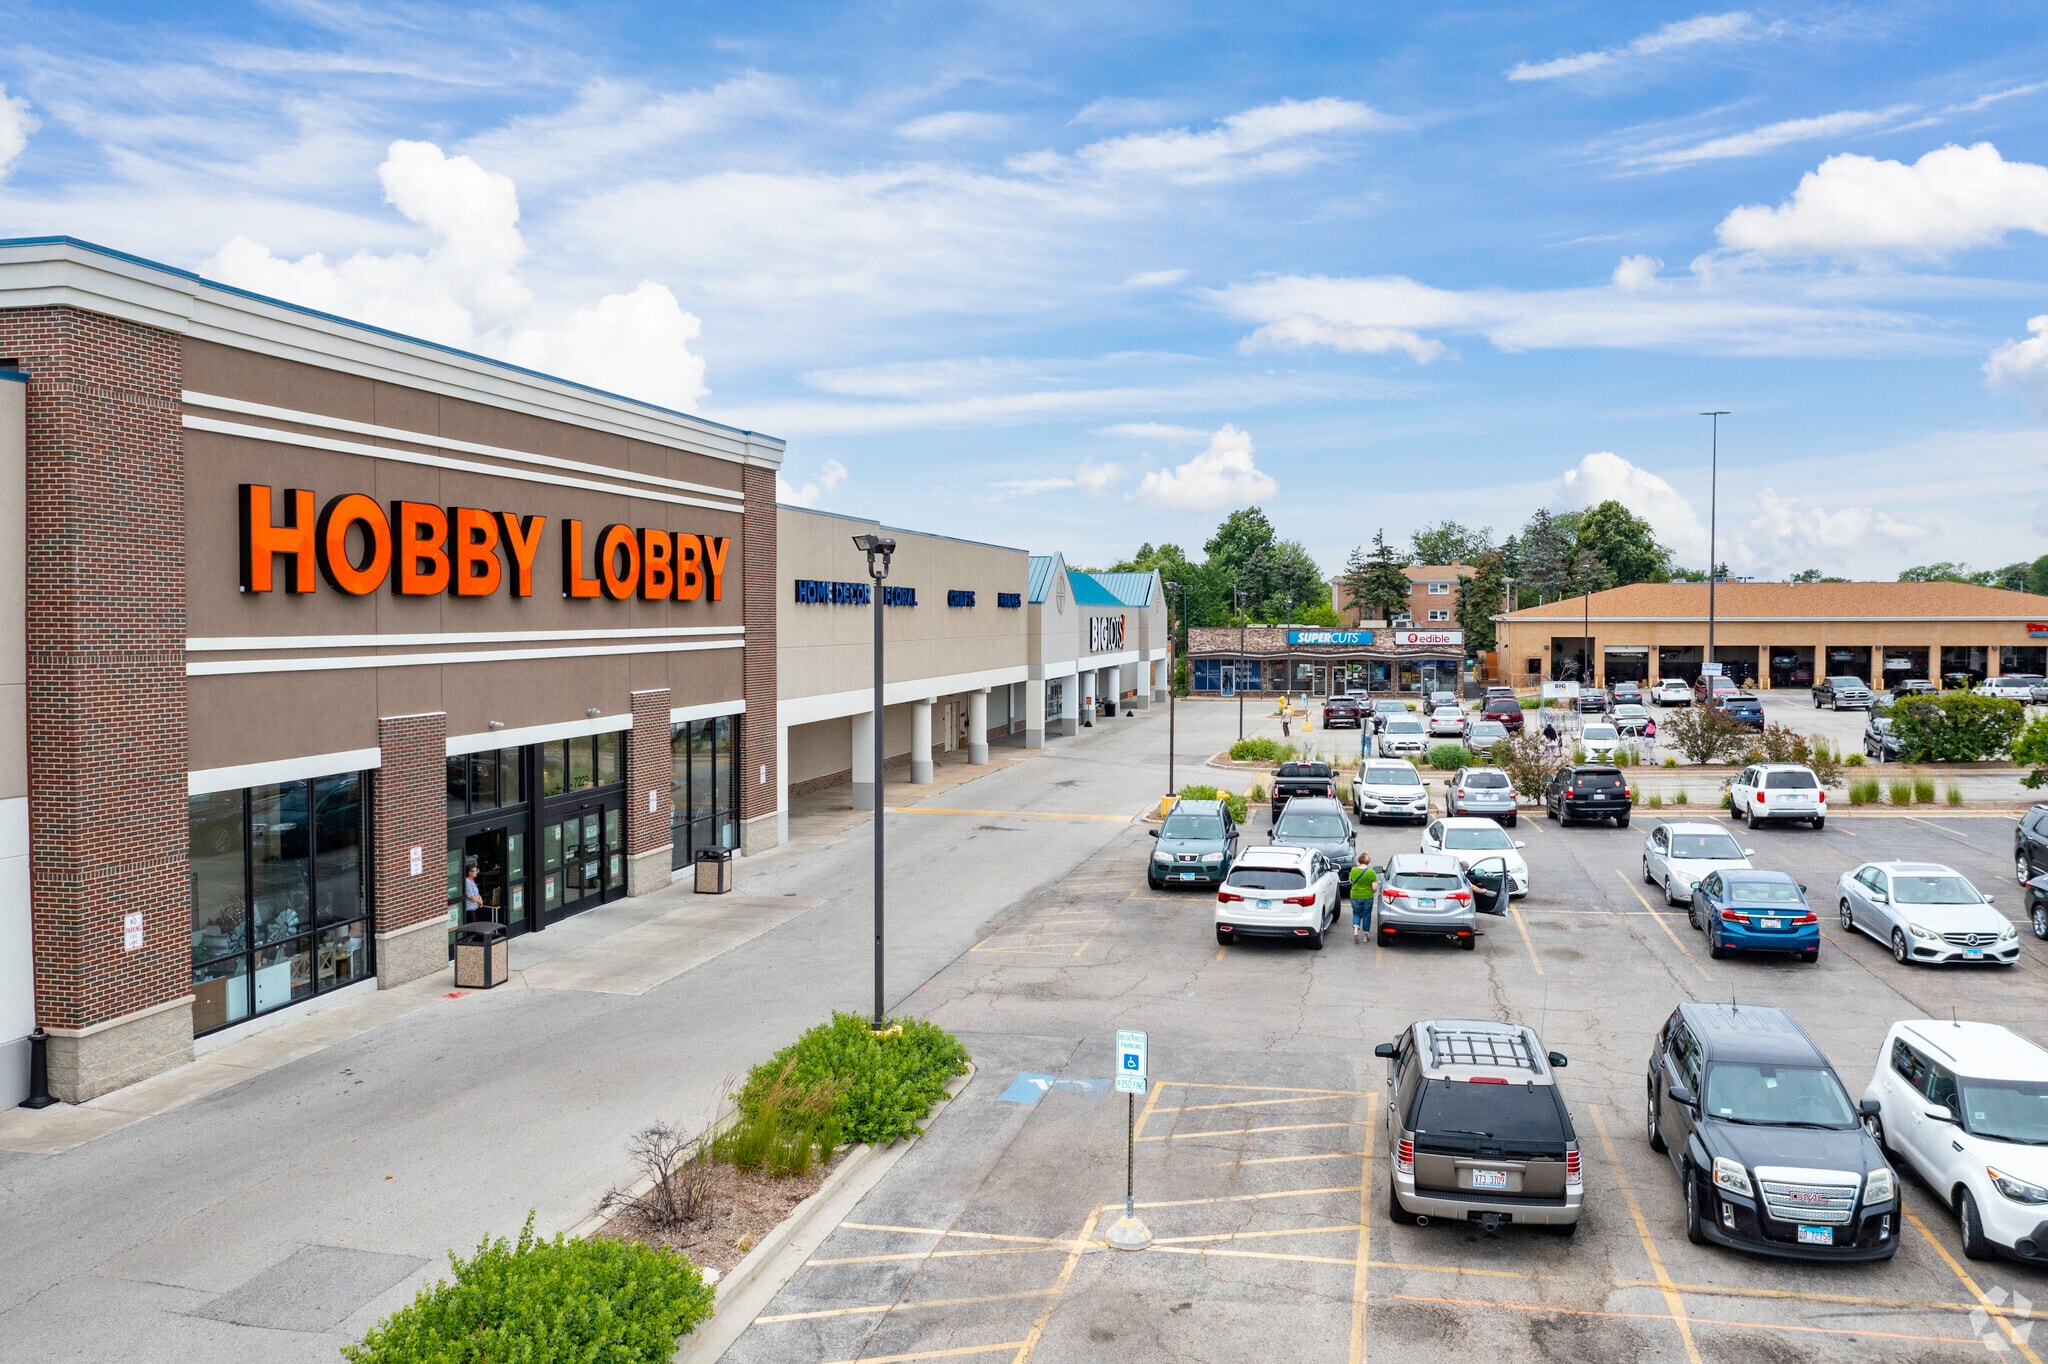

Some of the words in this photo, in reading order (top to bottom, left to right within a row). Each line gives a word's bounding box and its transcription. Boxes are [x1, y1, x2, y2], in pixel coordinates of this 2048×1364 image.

[239, 484, 546, 598] HOBBY
[562, 519, 730, 601] LOBBY
[795, 579, 832, 603] HOME
[833, 582, 871, 605] DECOR
[1090, 617, 1108, 652] BIG
[1297, 632, 1360, 643] SUPERCUTS
[1419, 634, 1450, 643] edible
[1119, 1034, 1144, 1042] RESERVED
[1133, 1082, 1144, 1090] FINE
[1790, 1191, 1829, 1203] GMC
